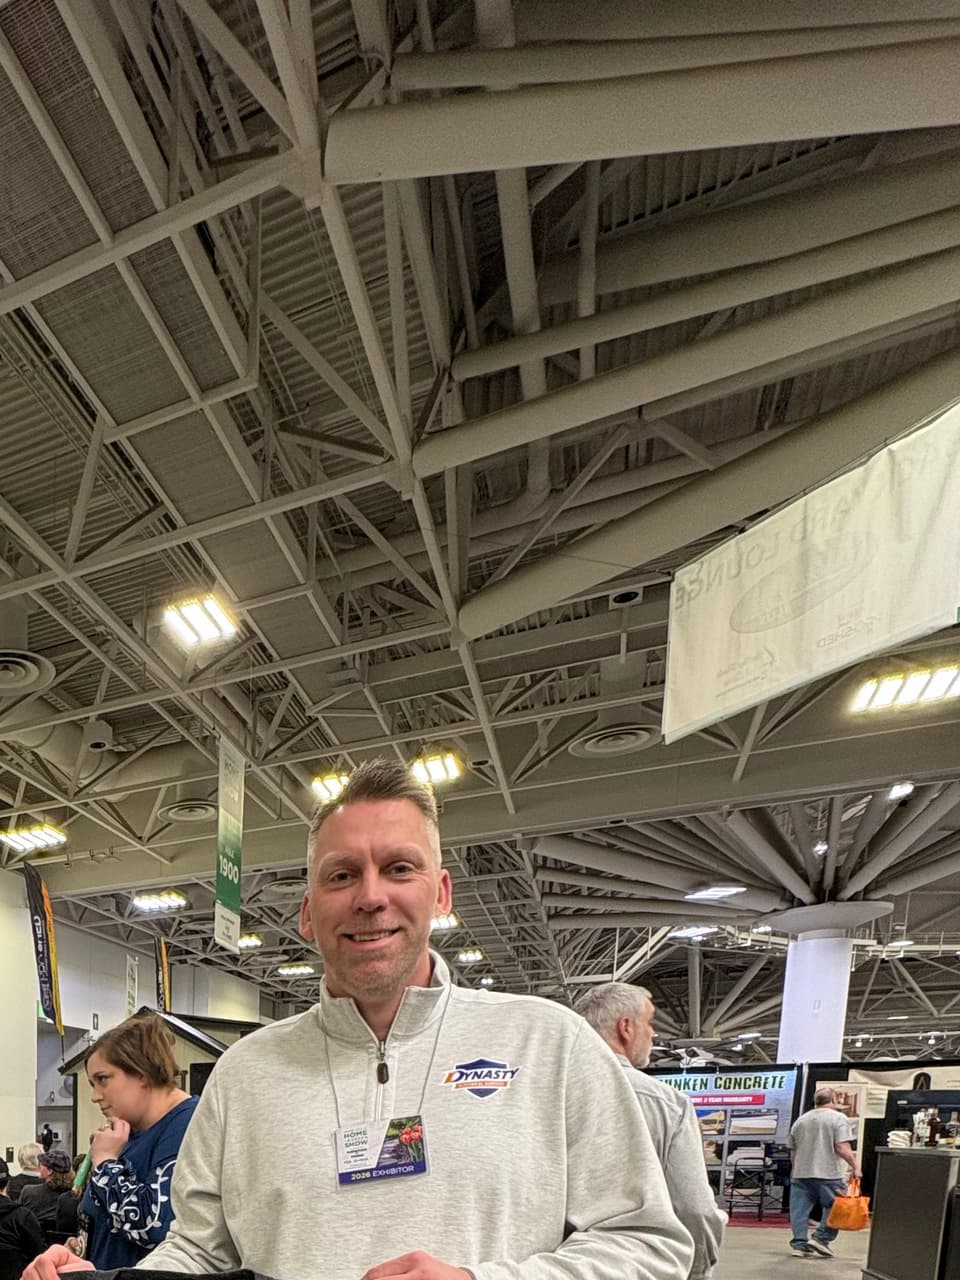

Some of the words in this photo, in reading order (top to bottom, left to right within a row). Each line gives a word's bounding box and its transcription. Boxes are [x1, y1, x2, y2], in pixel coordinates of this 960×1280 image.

[219, 854, 239, 884] 1900
[444, 1067, 520, 1085] DYNASTY
[714, 1075, 786, 1090] CONCRETE
[372, 1165, 415, 1177] EXHIBITOR
